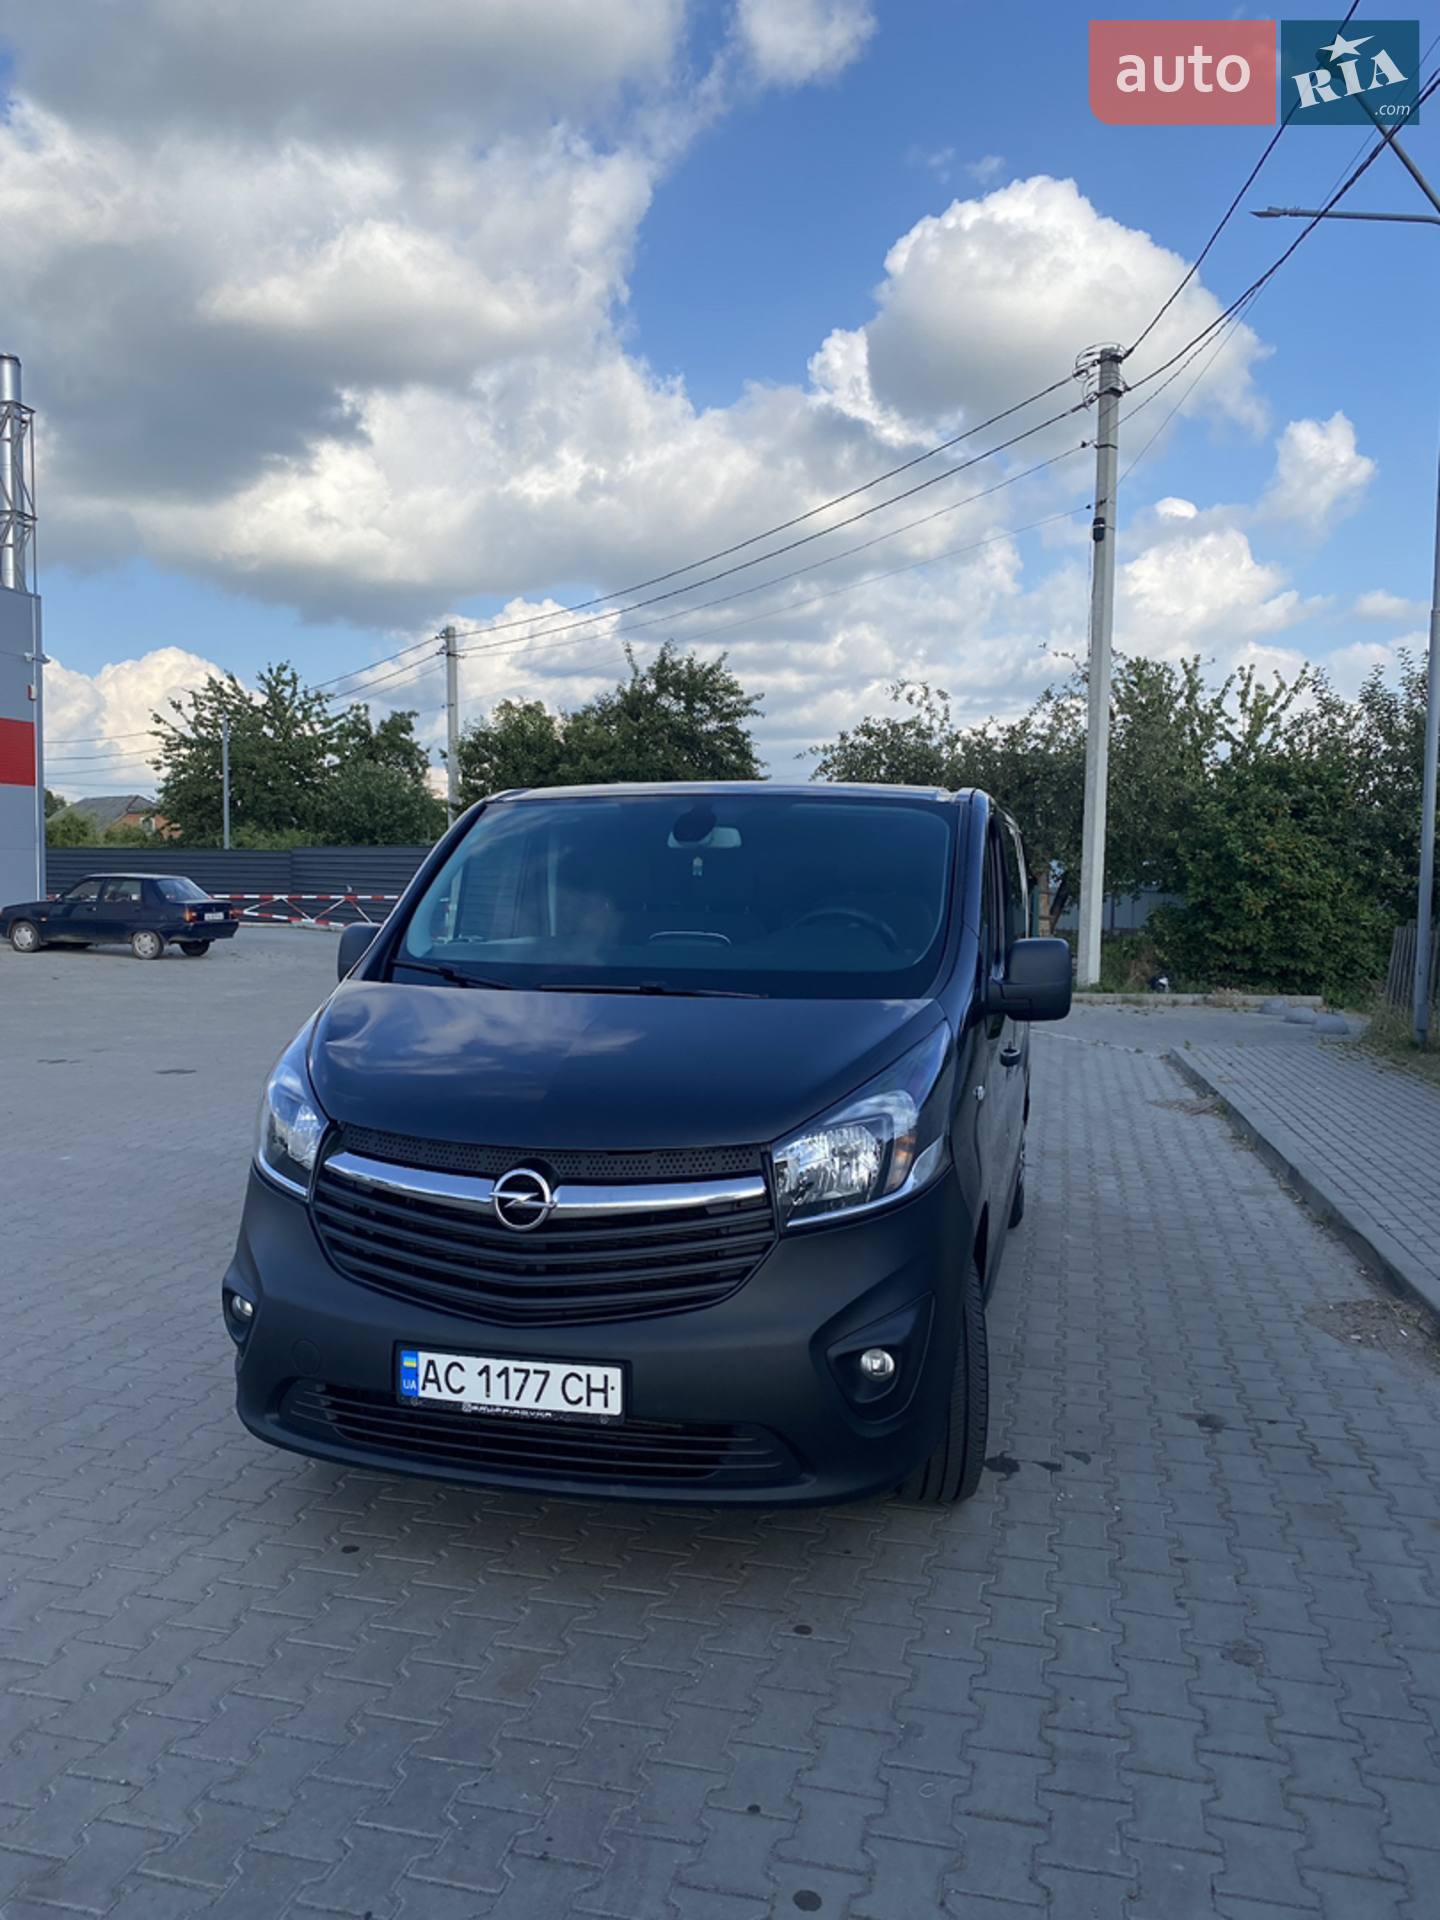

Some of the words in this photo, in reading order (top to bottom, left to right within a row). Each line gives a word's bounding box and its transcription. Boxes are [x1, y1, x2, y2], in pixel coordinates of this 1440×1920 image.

[403, 1379, 417, 1390] UA
[421, 1359, 466, 1395] AC
[477, 1364, 550, 1403] 1177
[561, 1372, 609, 1409] CH
